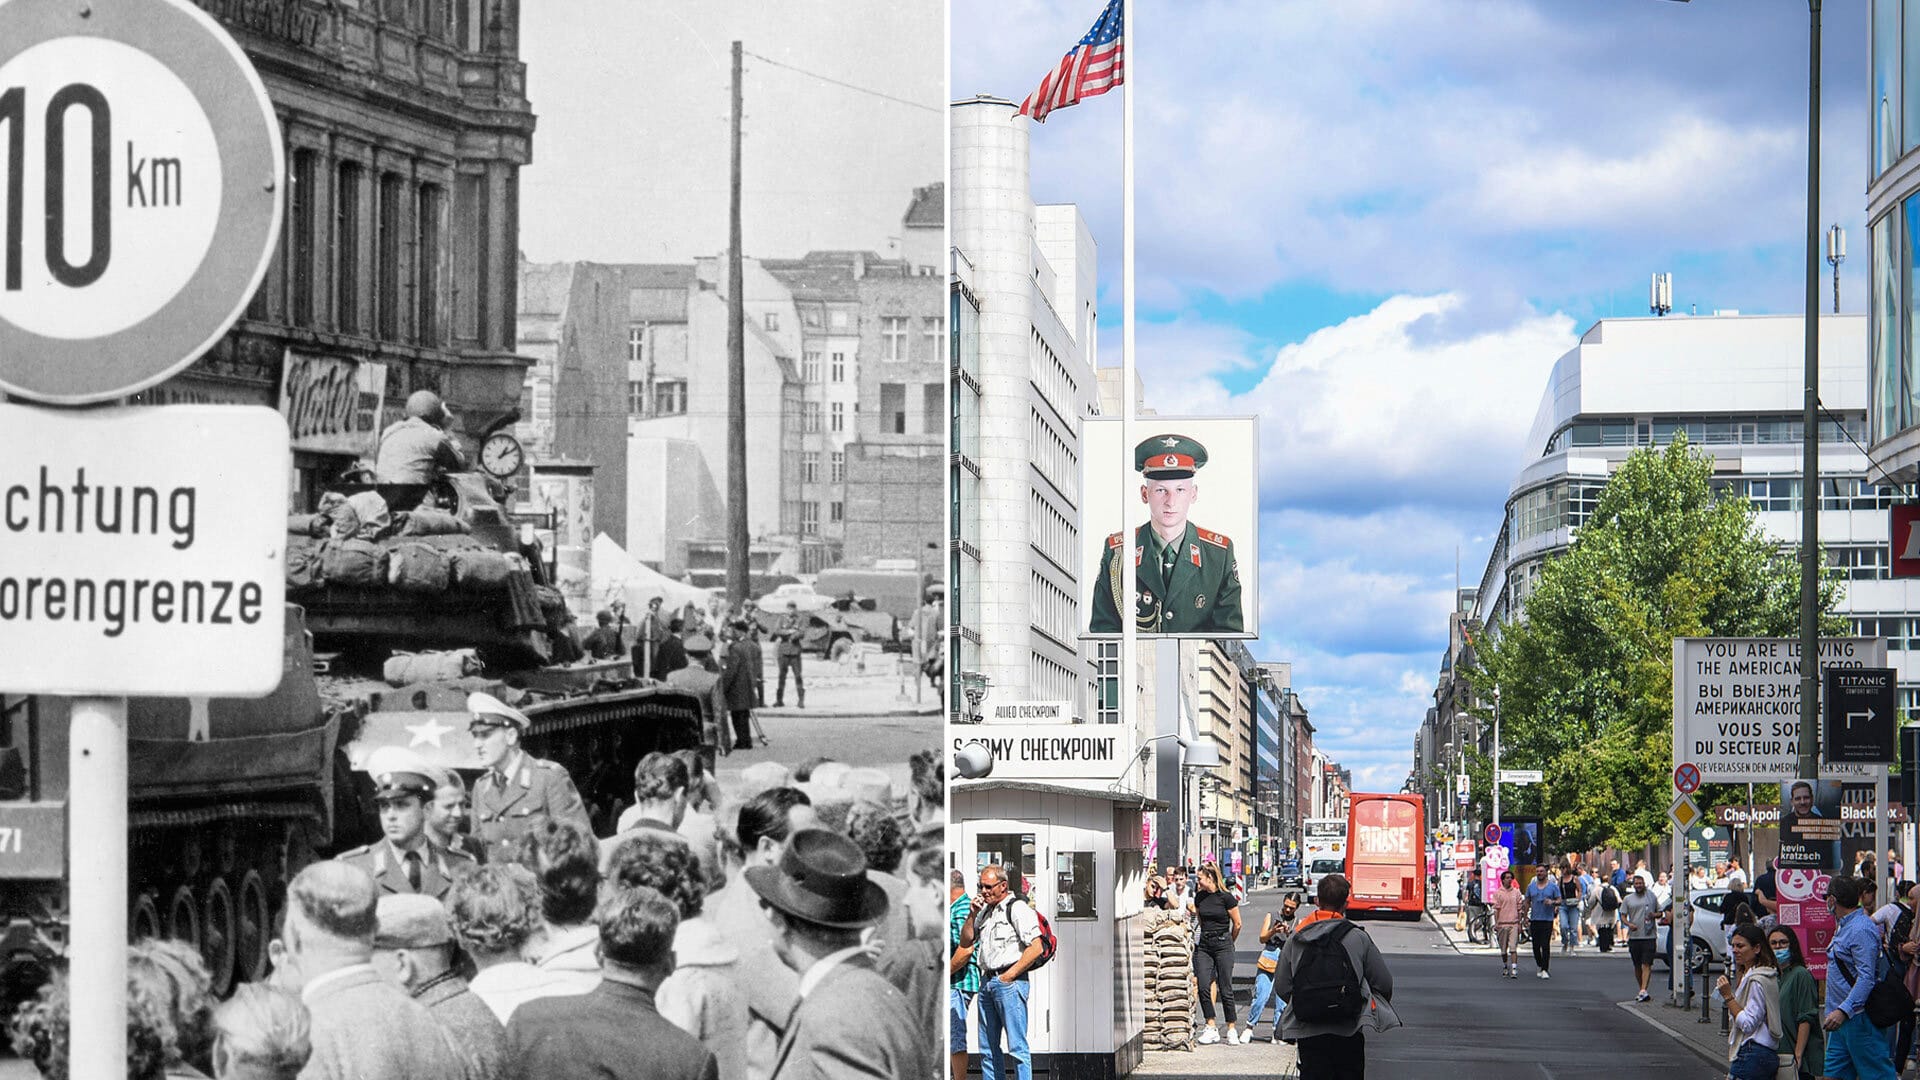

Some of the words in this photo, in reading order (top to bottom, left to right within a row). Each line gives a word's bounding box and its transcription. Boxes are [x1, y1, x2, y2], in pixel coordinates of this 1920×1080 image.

[0, 83, 111, 291] 10
[127, 141, 182, 208] km
[5, 465, 196, 550] chtung
[1705, 643, 1737, 657] YOU
[1747, 643, 1777, 657] ARE
[1788, 643, 1854, 657] LEVING
[1697, 661, 1721, 675] THE
[1729, 661, 1801, 675] AMERICAN
[1839, 676, 1886, 685] TITANIC
[1699, 684, 1723, 698] ВЫ
[1733, 684, 1802, 698] ВЫЕЗЖА
[995, 705, 1017, 718] ALLIED
[1019, 705, 1060, 718] CHECKPOINT
[1718, 722, 1762, 737] VOUS
[1021, 738, 1115, 760] CHECKPOINT
[1696, 741, 1713, 755] DU
[1719, 741, 1781, 755] SECTEUR
[1709, 762, 1751, 773] VERLASSEN
[1753, 762, 1766, 773] DEN
[1724, 808, 1781, 823] Chekpoi
[1841, 806, 1897, 819] Blackx
[1781, 844, 1806, 852] kevin
[1780, 851, 1821, 861] kratzsch
